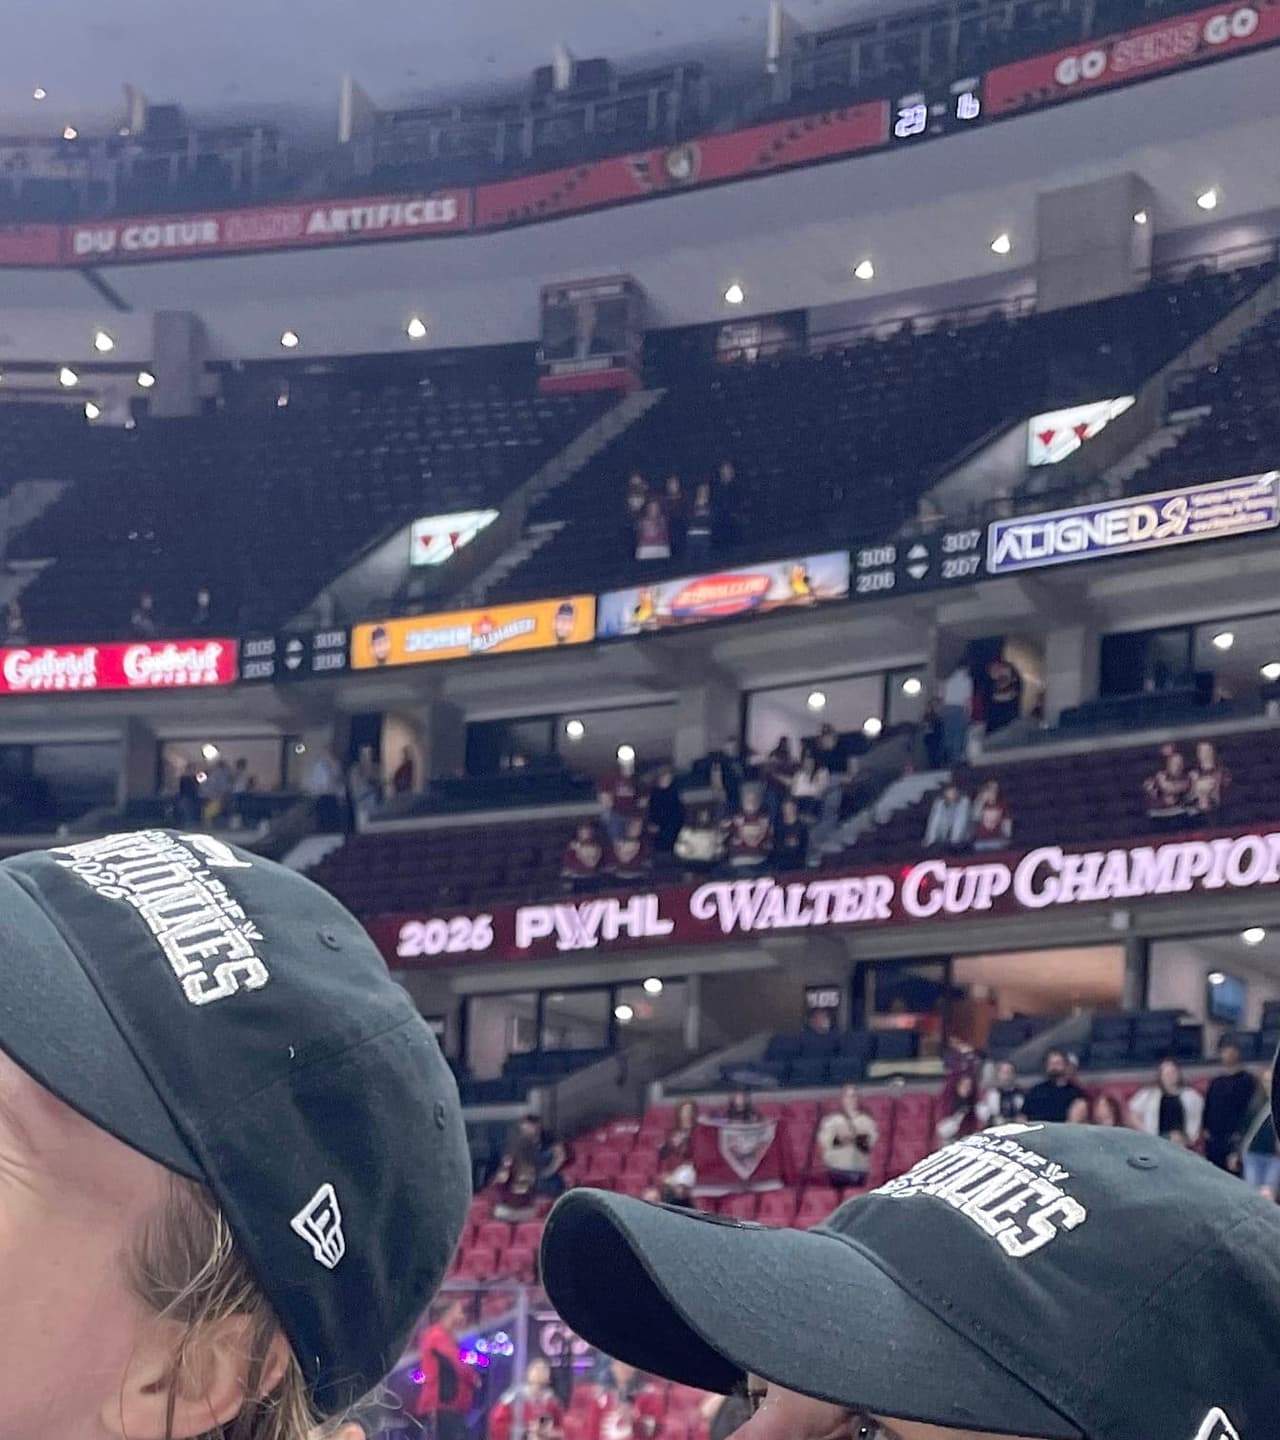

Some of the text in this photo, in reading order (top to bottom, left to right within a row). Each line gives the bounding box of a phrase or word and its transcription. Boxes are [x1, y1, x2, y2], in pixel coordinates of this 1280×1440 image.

[1056, 50, 1107, 86] GO
[1204, 8, 1259, 44] GO
[74, 229, 117, 255] DU
[307, 198, 459, 235] ARTIFICES
[397, 913, 494, 957] 2026
[516, 894, 674, 949] PWHL
[690, 875, 894, 933] WALTER
[902, 859, 1013, 918] CUP
